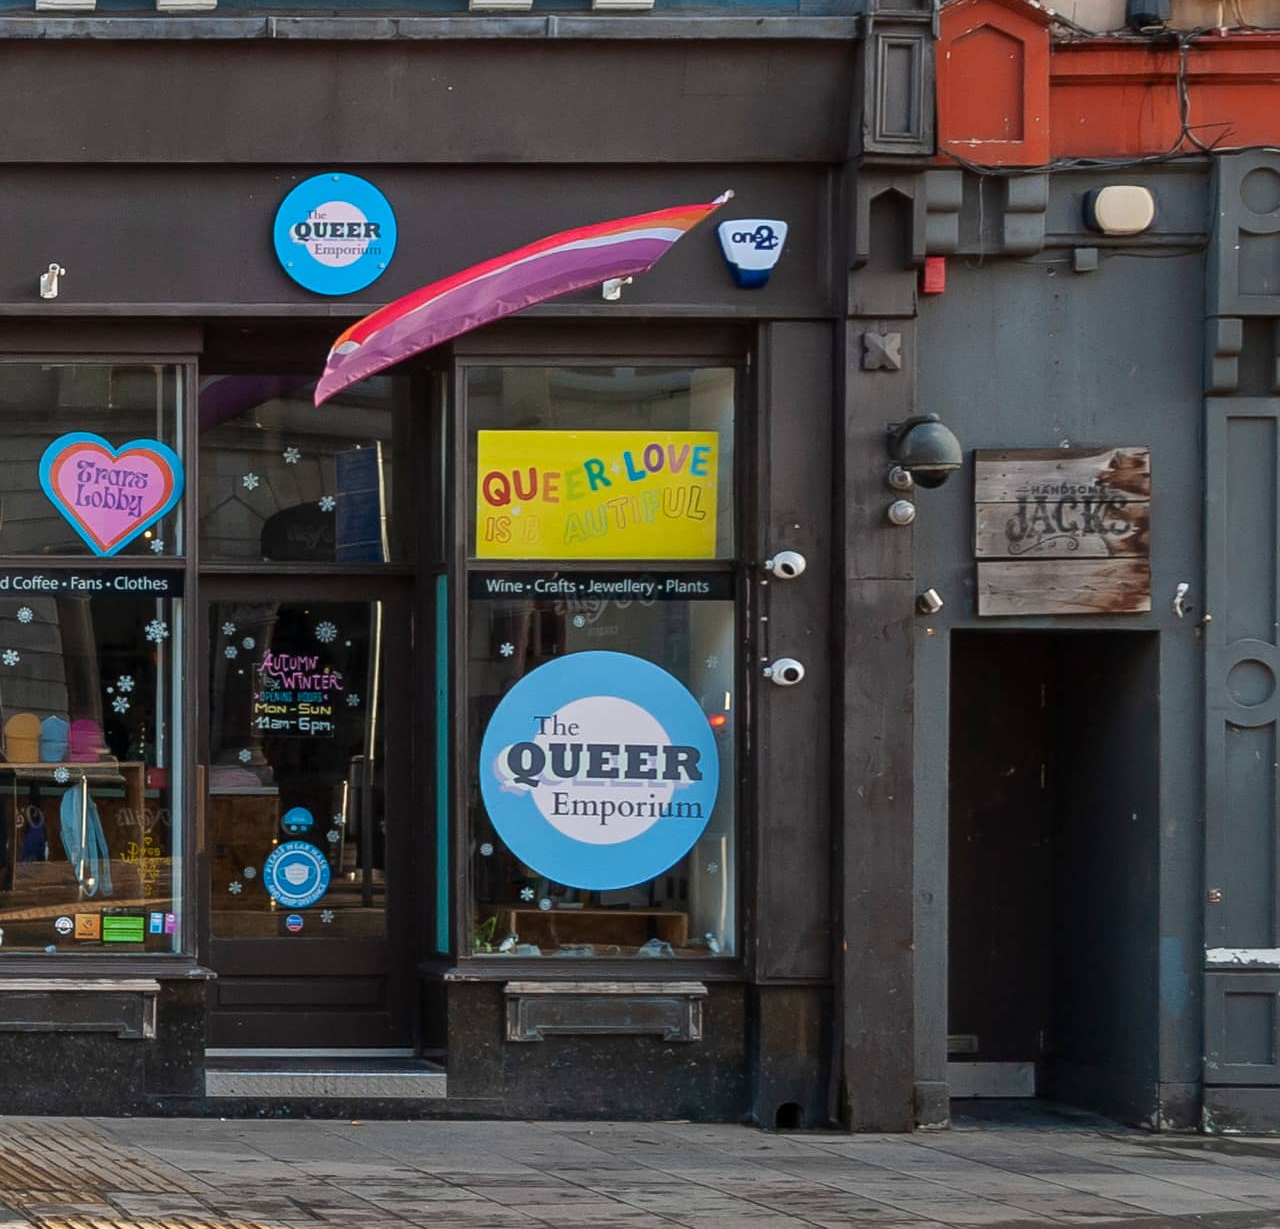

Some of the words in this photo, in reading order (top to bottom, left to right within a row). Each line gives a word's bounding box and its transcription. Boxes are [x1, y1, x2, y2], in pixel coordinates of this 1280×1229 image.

[306, 210, 328, 220] The
[294, 222, 382, 242] QUEER
[314, 243, 383, 259] Emporium
[77, 460, 149, 489] Trans
[482, 457, 612, 507] QUEER
[623, 443, 712, 482] LOVE
[1031, 484, 1107, 495] HANDSOME
[75, 483, 144, 518] Lobby
[485, 516, 512, 543] IS
[521, 485, 707, 545] BAUTIFUL
[12, 577, 59, 591] Coffee
[70, 577, 103, 591] Fans
[114, 576, 169, 591] Clothes
[486, 579, 523, 593] Wine
[534, 578, 576, 593] Crafts
[587, 579, 654, 597] Jewellery
[666, 579, 710, 593] Plants
[257, 653, 320, 672] AUTUMN
[280, 672, 344, 690] WINTER
[533, 714, 580, 737] The
[506, 741, 703, 788] QUEER
[551, 791, 704, 826] Emporium
